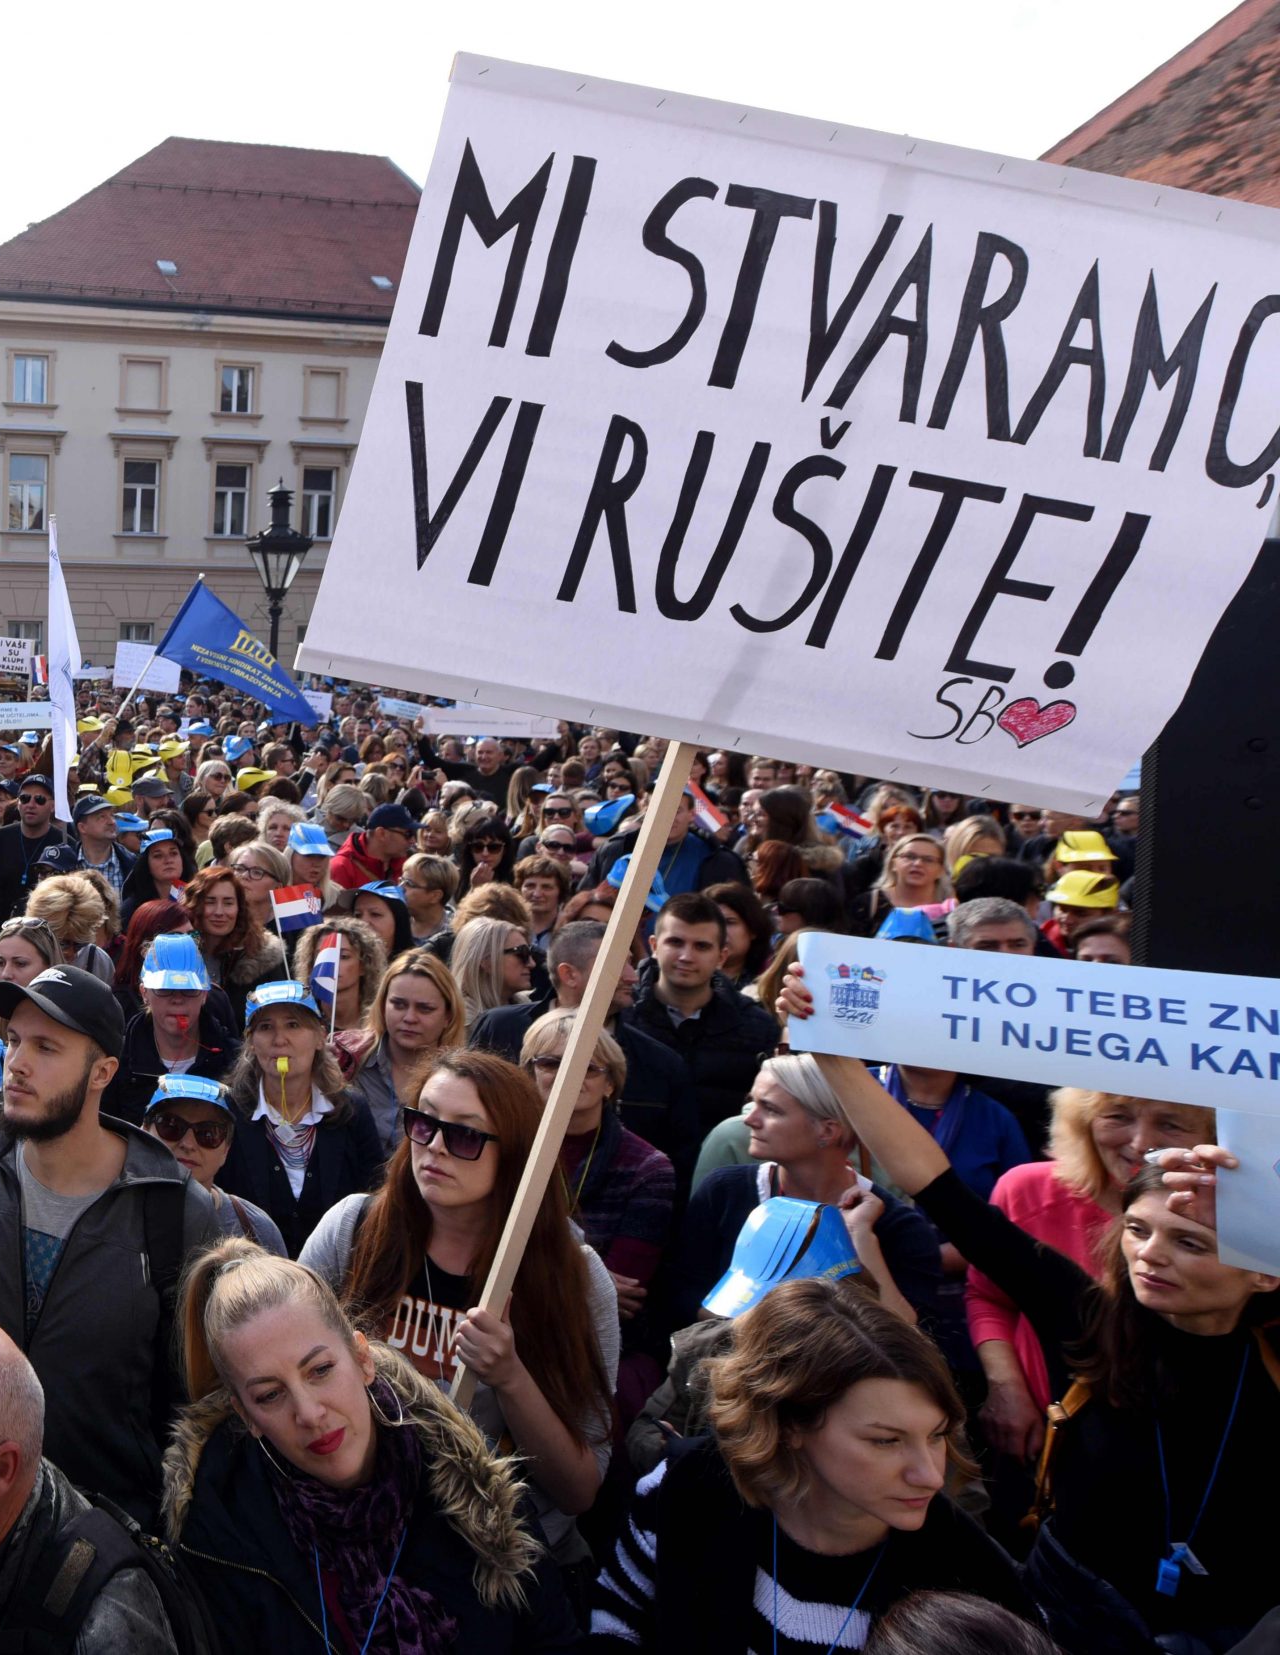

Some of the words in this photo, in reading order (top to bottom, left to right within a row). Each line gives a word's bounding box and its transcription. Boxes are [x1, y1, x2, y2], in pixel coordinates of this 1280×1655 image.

[418, 137, 597, 357] MI
[605, 177, 1280, 509] STVARAMO,
[405, 381, 546, 586] VI
[557, 415, 1151, 690] RUŠITE!
[2, 656, 24, 664] KLUPE
[6, 639, 27, 649] VAŠE
[191, 644, 228, 663] NEZAVISNI
[228, 657, 262, 679] SINDIKAT
[261, 672, 297, 699] ZNANOSTI
[201, 656, 230, 672] VISOKOG
[230, 667, 282, 699] OBRAZOVANJA
[942, 976, 1037, 1007] TKO
[1056, 987, 1187, 1025] TEBE
[942, 1013, 980, 1042] TI
[1002, 1023, 1169, 1066] NJEGA
